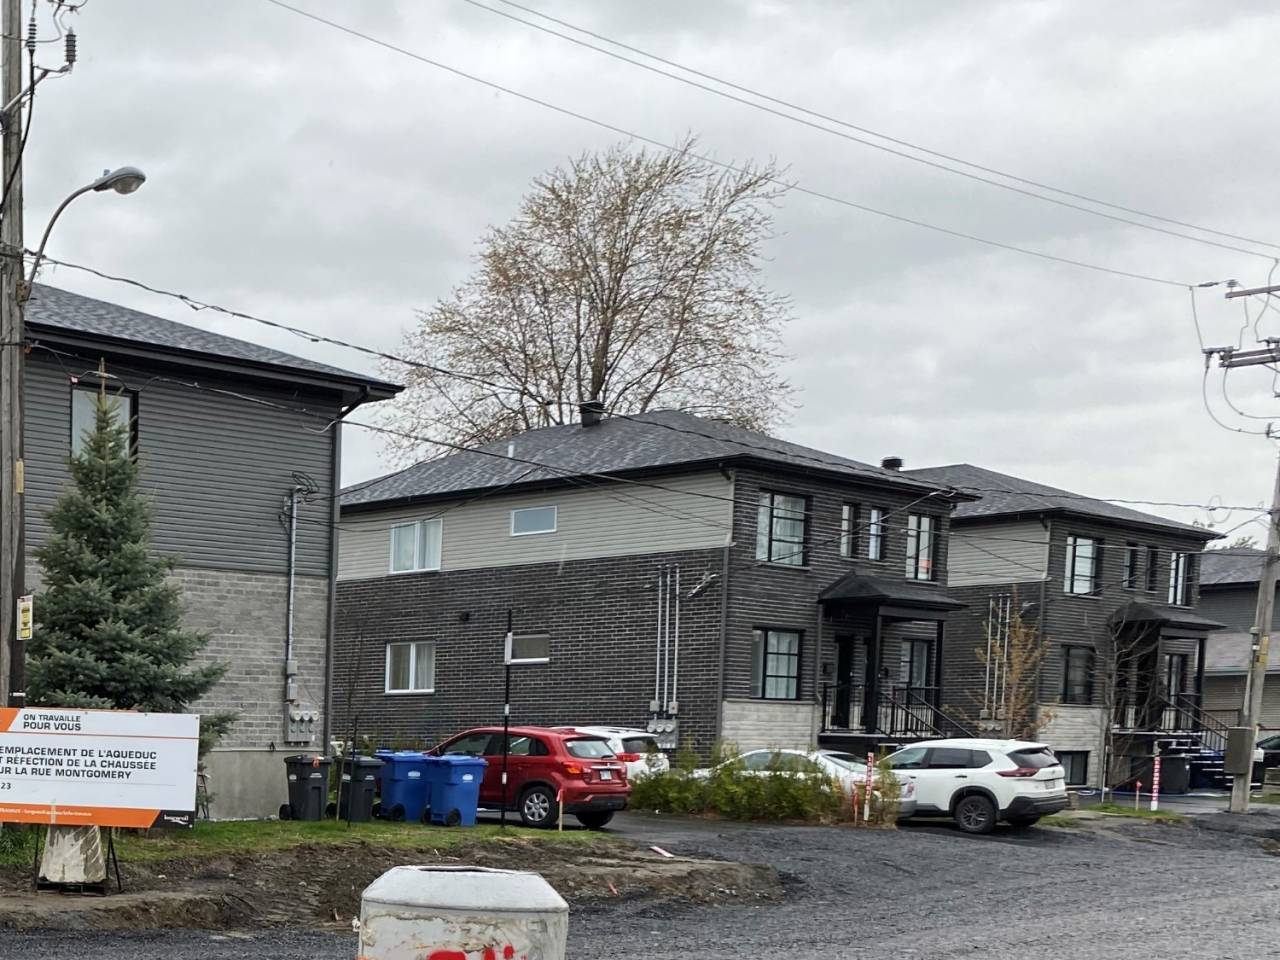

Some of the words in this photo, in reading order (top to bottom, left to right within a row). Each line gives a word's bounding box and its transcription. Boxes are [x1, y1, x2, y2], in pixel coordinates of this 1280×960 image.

[38, 714, 81, 722] TRAVAILLE
[23, 721, 51, 730] POUR
[53, 722, 81, 731] VOUS
[80, 749, 95, 757] DE
[98, 749, 157, 759] L'AQUEDUC
[66, 758, 81, 767] DE
[15, 767, 28, 775] LA
[31, 767, 52, 776] RUE
[55, 769, 132, 779] MONTGOMERY
